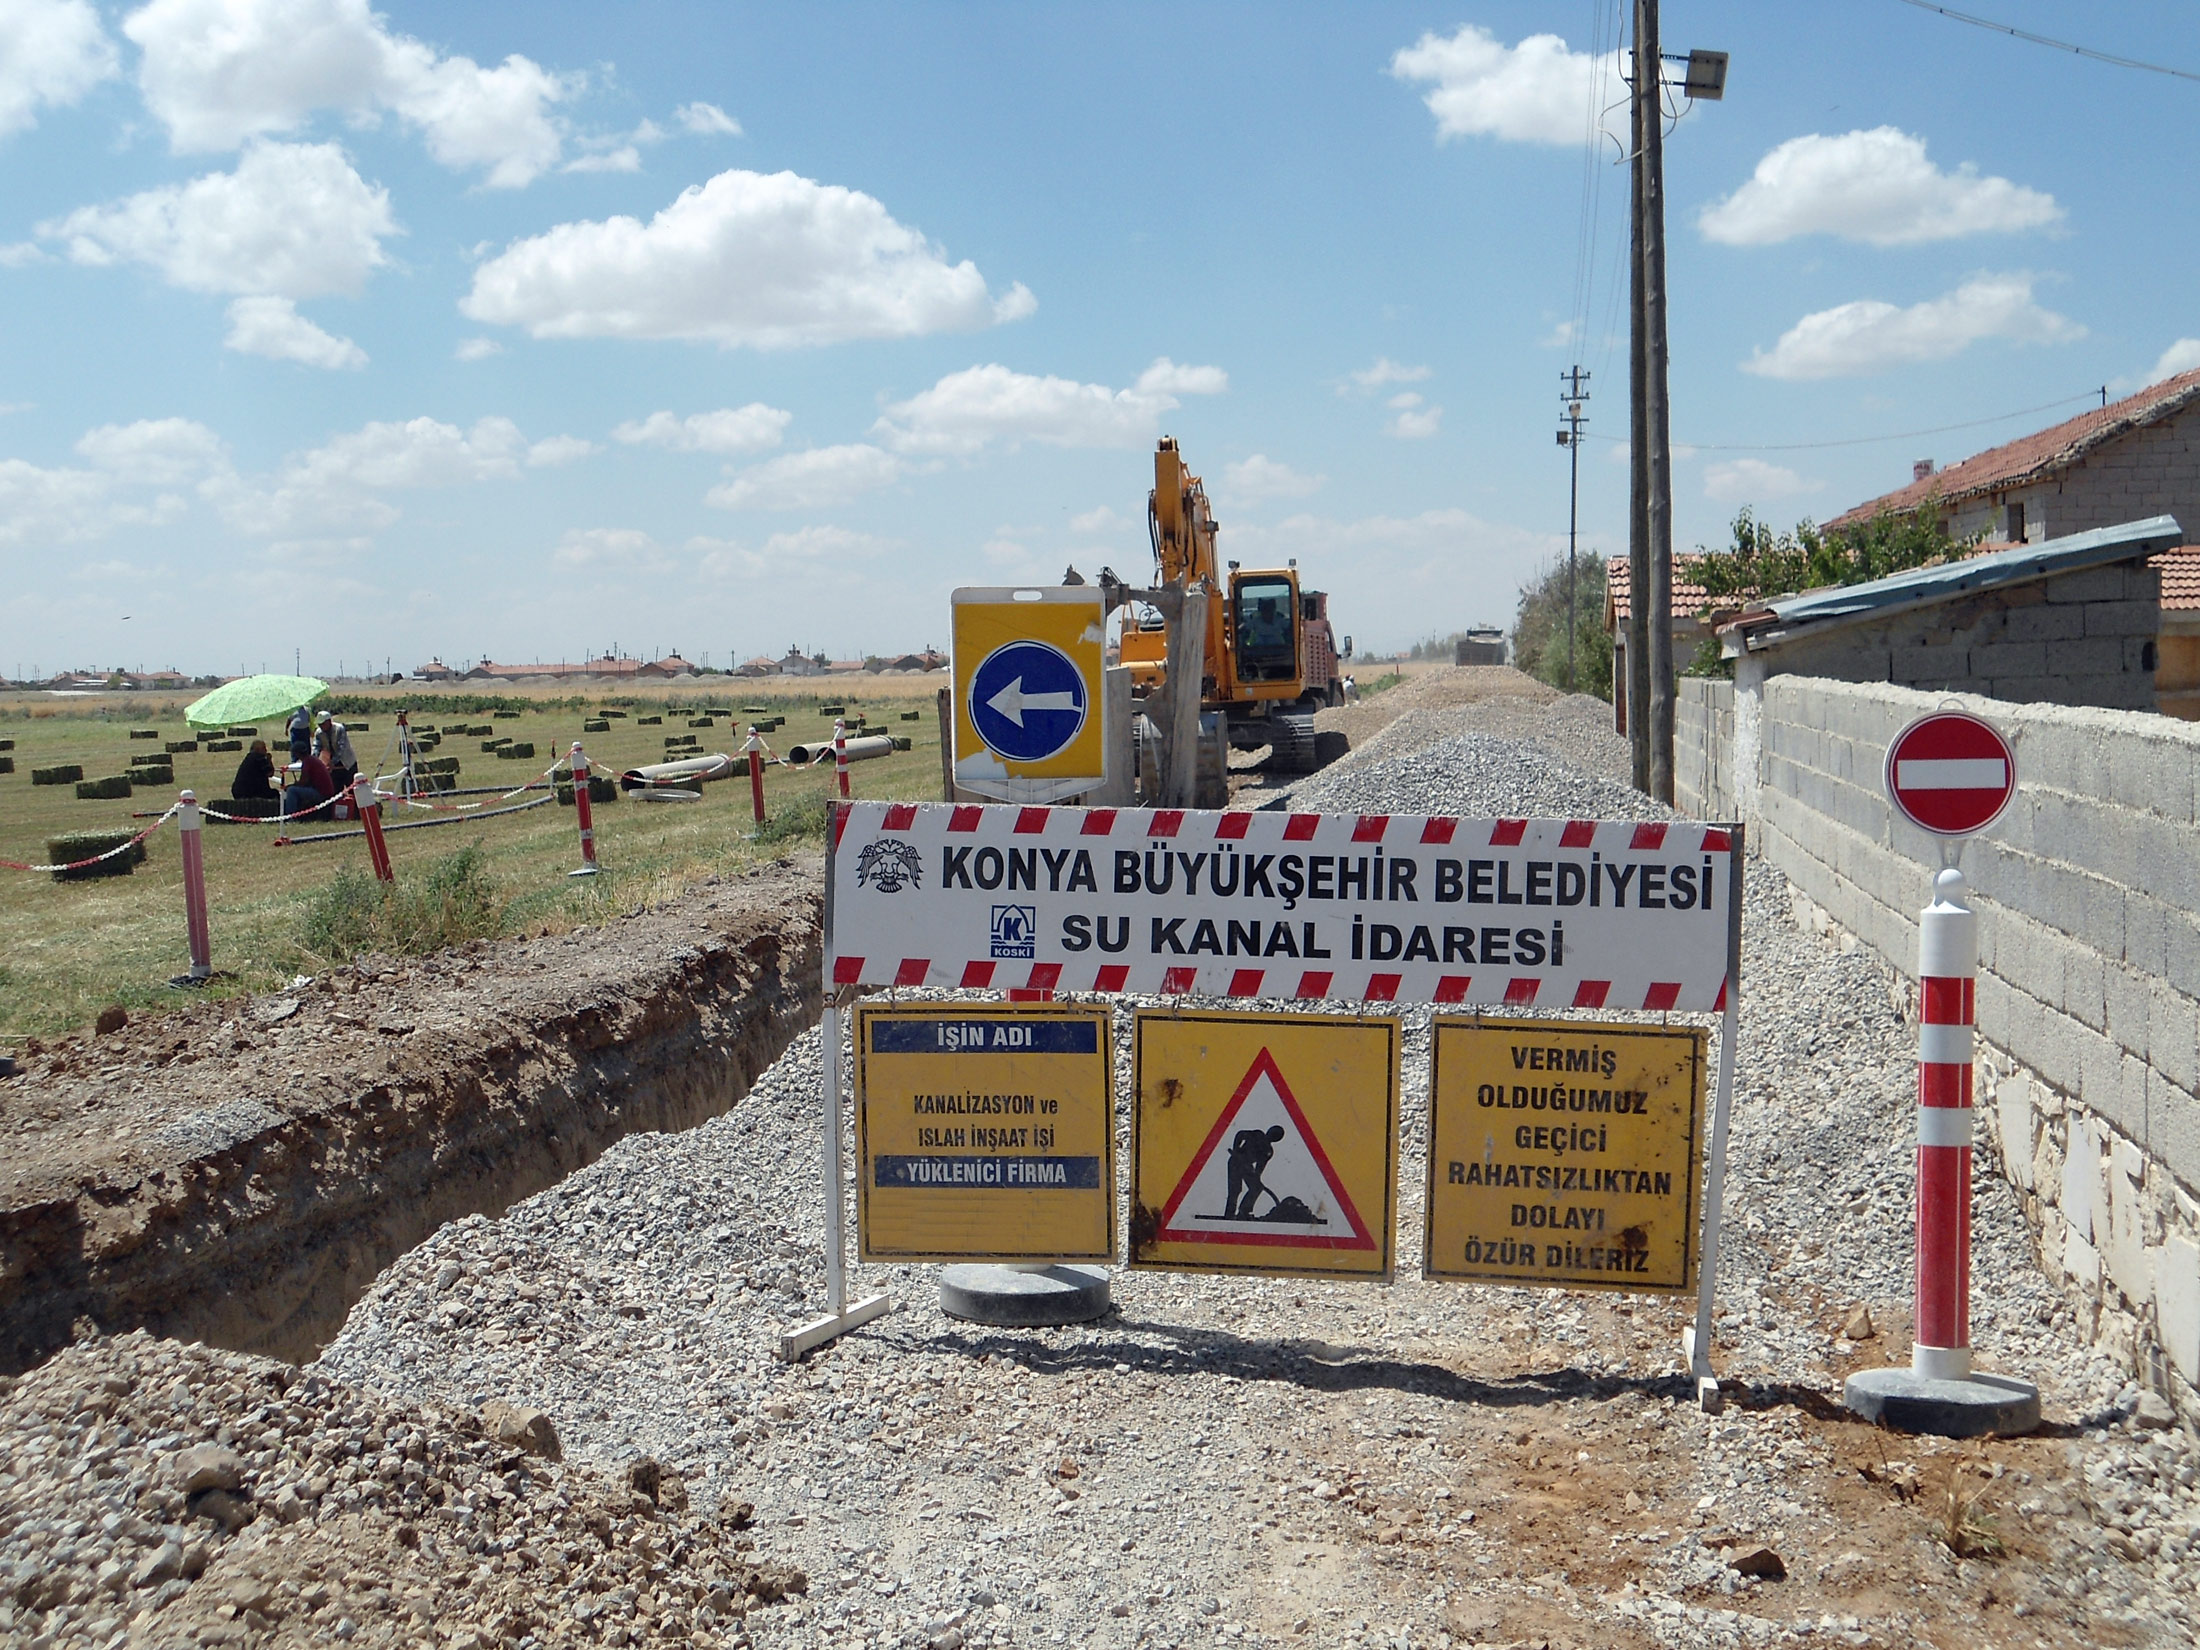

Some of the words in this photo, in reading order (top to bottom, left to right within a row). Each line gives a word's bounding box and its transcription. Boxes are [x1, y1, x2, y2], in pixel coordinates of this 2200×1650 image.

[943, 846, 1097, 893] KONYA
[1114, 841, 1418, 910] BÜYÜKŞEHİR
[1435, 851, 1713, 910] BELEDİYESİ
[994, 947, 1030, 957] KOSKİ
[1061, 914, 1130, 953] SU
[1151, 917, 1331, 959] KANAL
[1351, 914, 1564, 967] İDARESİ
[937, 1022, 984, 1051] İŞİN
[992, 1026, 1032, 1046] ADI
[1511, 1044, 1617, 1080] VERMİŞ
[914, 1091, 1034, 1115] KANALİZASYON
[1040, 1100, 1058, 1115] ve
[1477, 1082, 1648, 1115] OLDUĞUMUZ
[918, 1127, 965, 1147] ISLAH
[971, 1124, 1028, 1152] İNŞAAT
[1033, 1123, 1055, 1152] İŞİ
[1515, 1122, 1606, 1157] GEÇİCİ
[907, 1158, 1001, 1183] YÜKLENİCİ
[1007, 1158, 1067, 1183] FİRMA
[1448, 1161, 1671, 1196] RAHATSIZLIKTAN
[1511, 1204, 1605, 1231] DOLAYI
[1464, 1235, 1536, 1267] ÖZÜR
